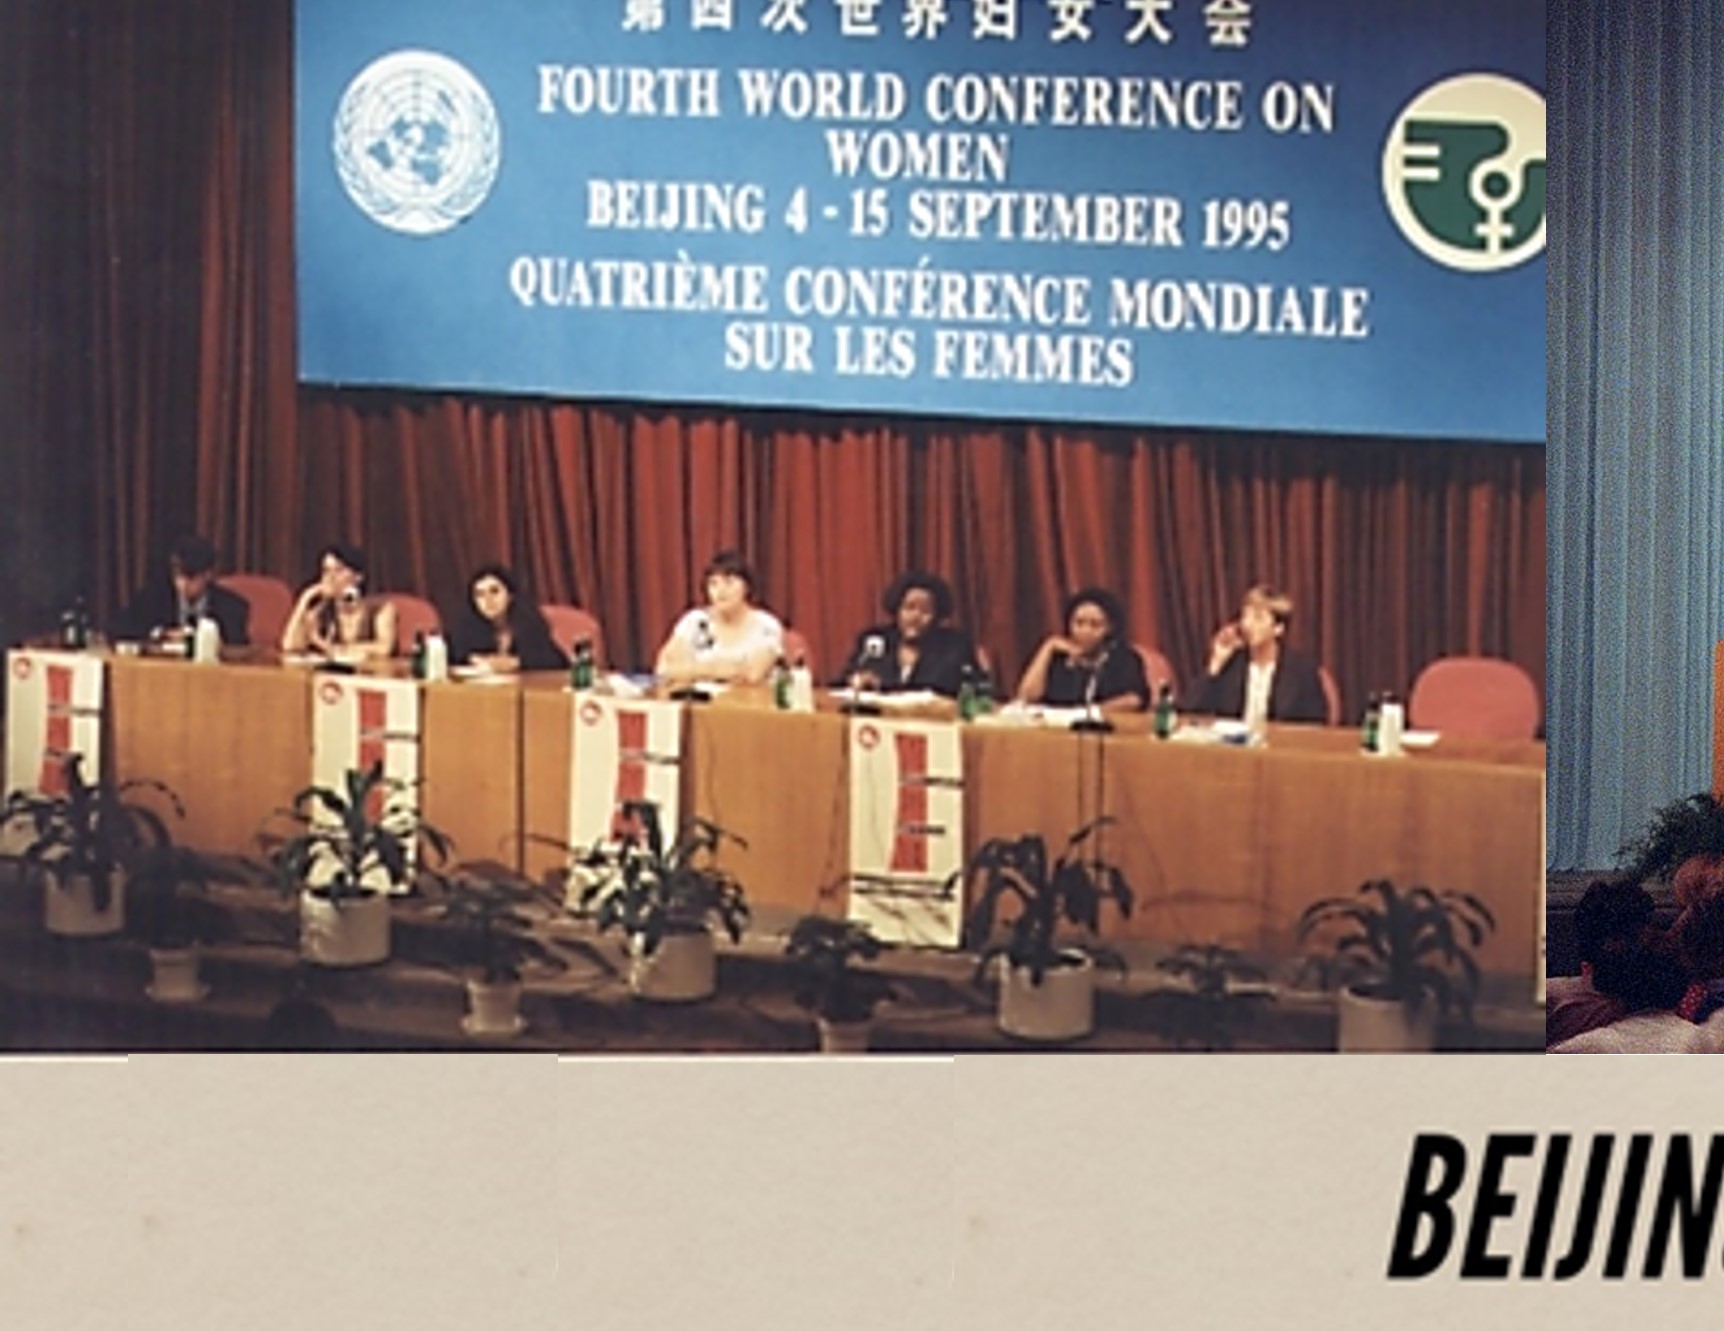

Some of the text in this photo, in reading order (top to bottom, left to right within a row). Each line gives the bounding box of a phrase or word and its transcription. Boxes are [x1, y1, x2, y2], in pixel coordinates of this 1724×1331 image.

[538, 65, 1333, 131] FOURTH WORLD CONFERENCE ON
[826, 130, 1008, 182] WOMEN
[588, 180, 765, 234] BEIJING
[909, 189, 1182, 247] SEPTEMBER
[1203, 200, 1290, 251] 1995
[510, 249, 1368, 338] QUATRIÈME CONFÉRENCE MONDIALE
[725, 321, 1134, 386] SUR LES FEMMES
